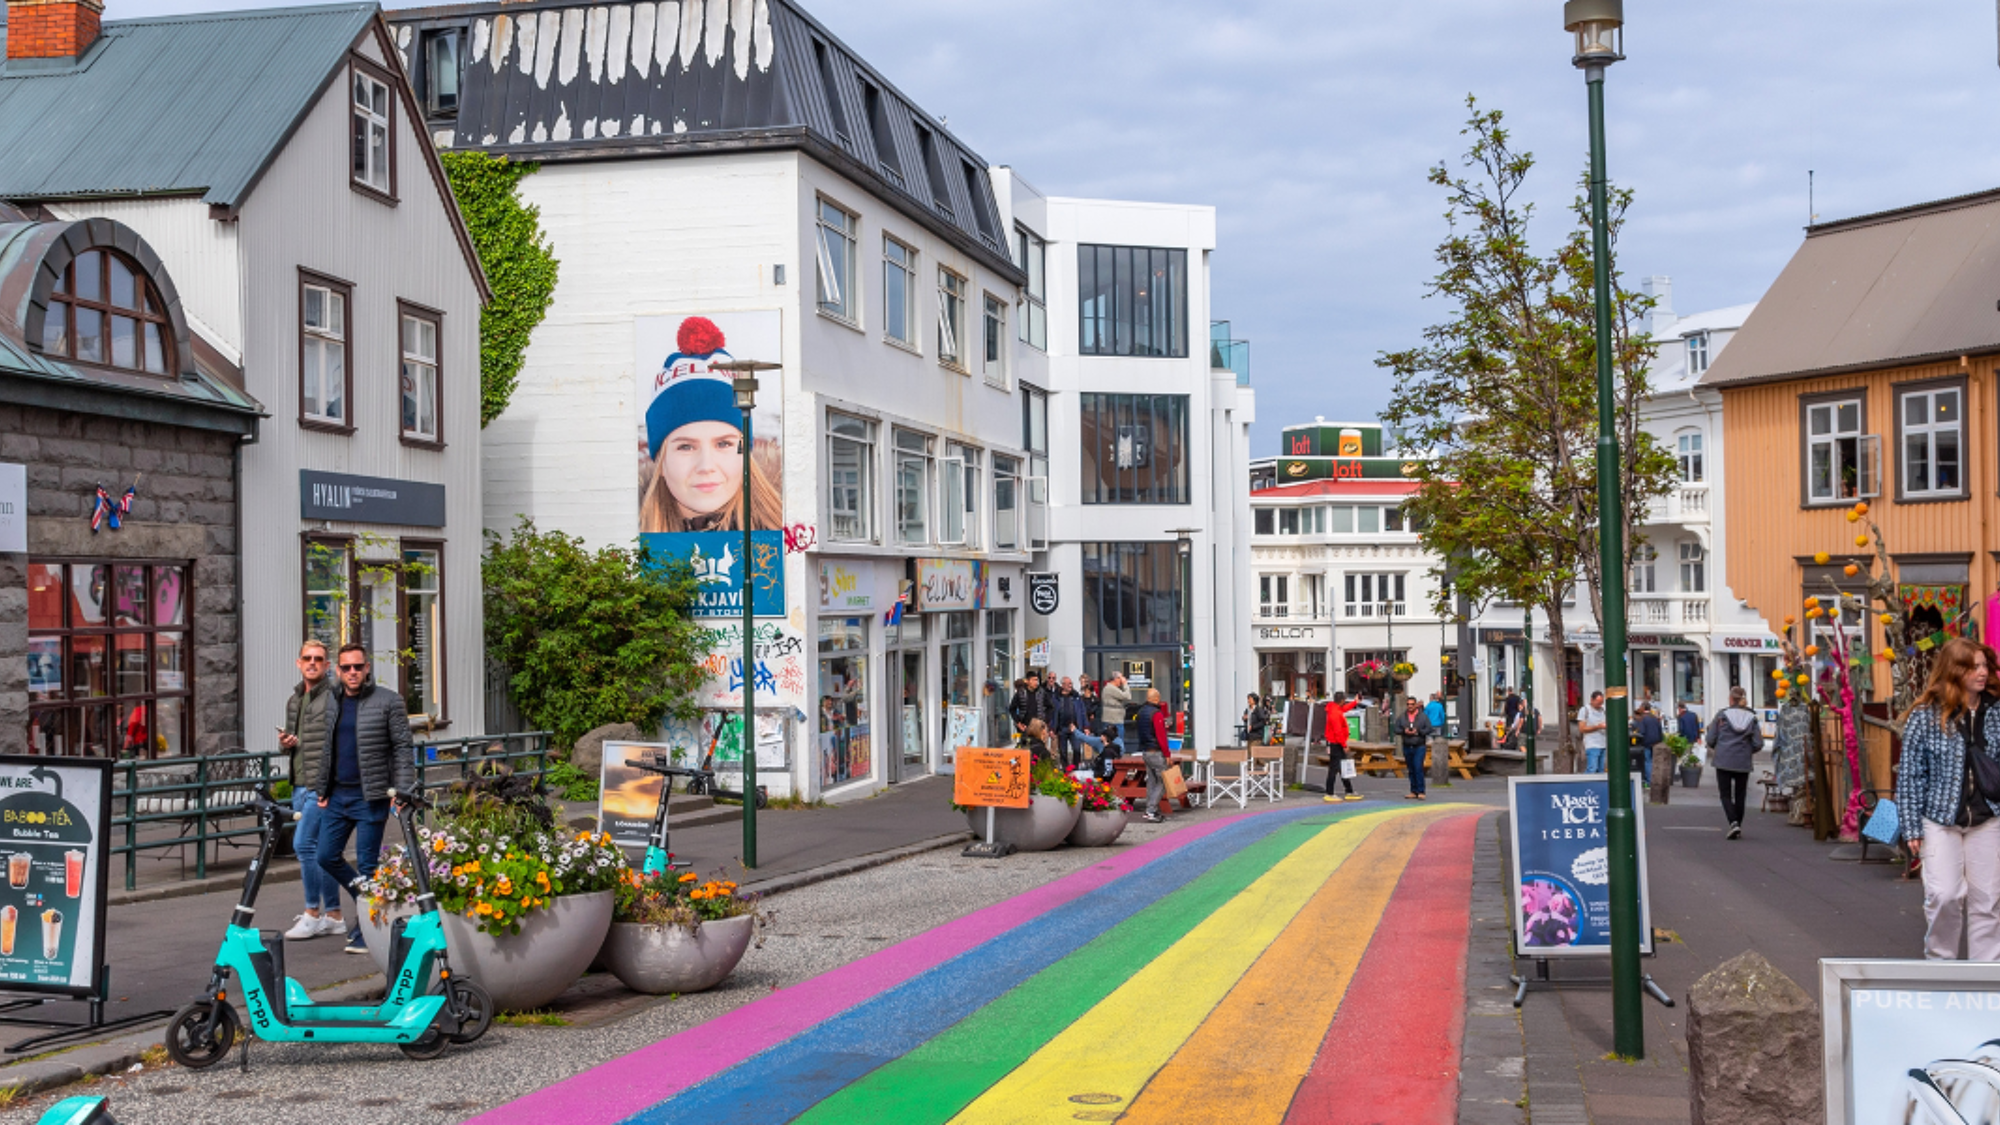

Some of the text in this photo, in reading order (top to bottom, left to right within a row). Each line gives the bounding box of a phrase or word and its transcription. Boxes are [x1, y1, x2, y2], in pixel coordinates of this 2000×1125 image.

[1291, 435, 1311, 455] loft
[1332, 459, 1363, 478] loft
[1723, 636, 1762, 648] CORNER
[15, 778, 33, 788] ARE
[1551, 789, 1599, 808] Magic
[1562, 805, 1602, 824] ICE
[13, 828, 59, 839] Bubble Tea
[1855, 990, 2000, 1011] PURE AND
